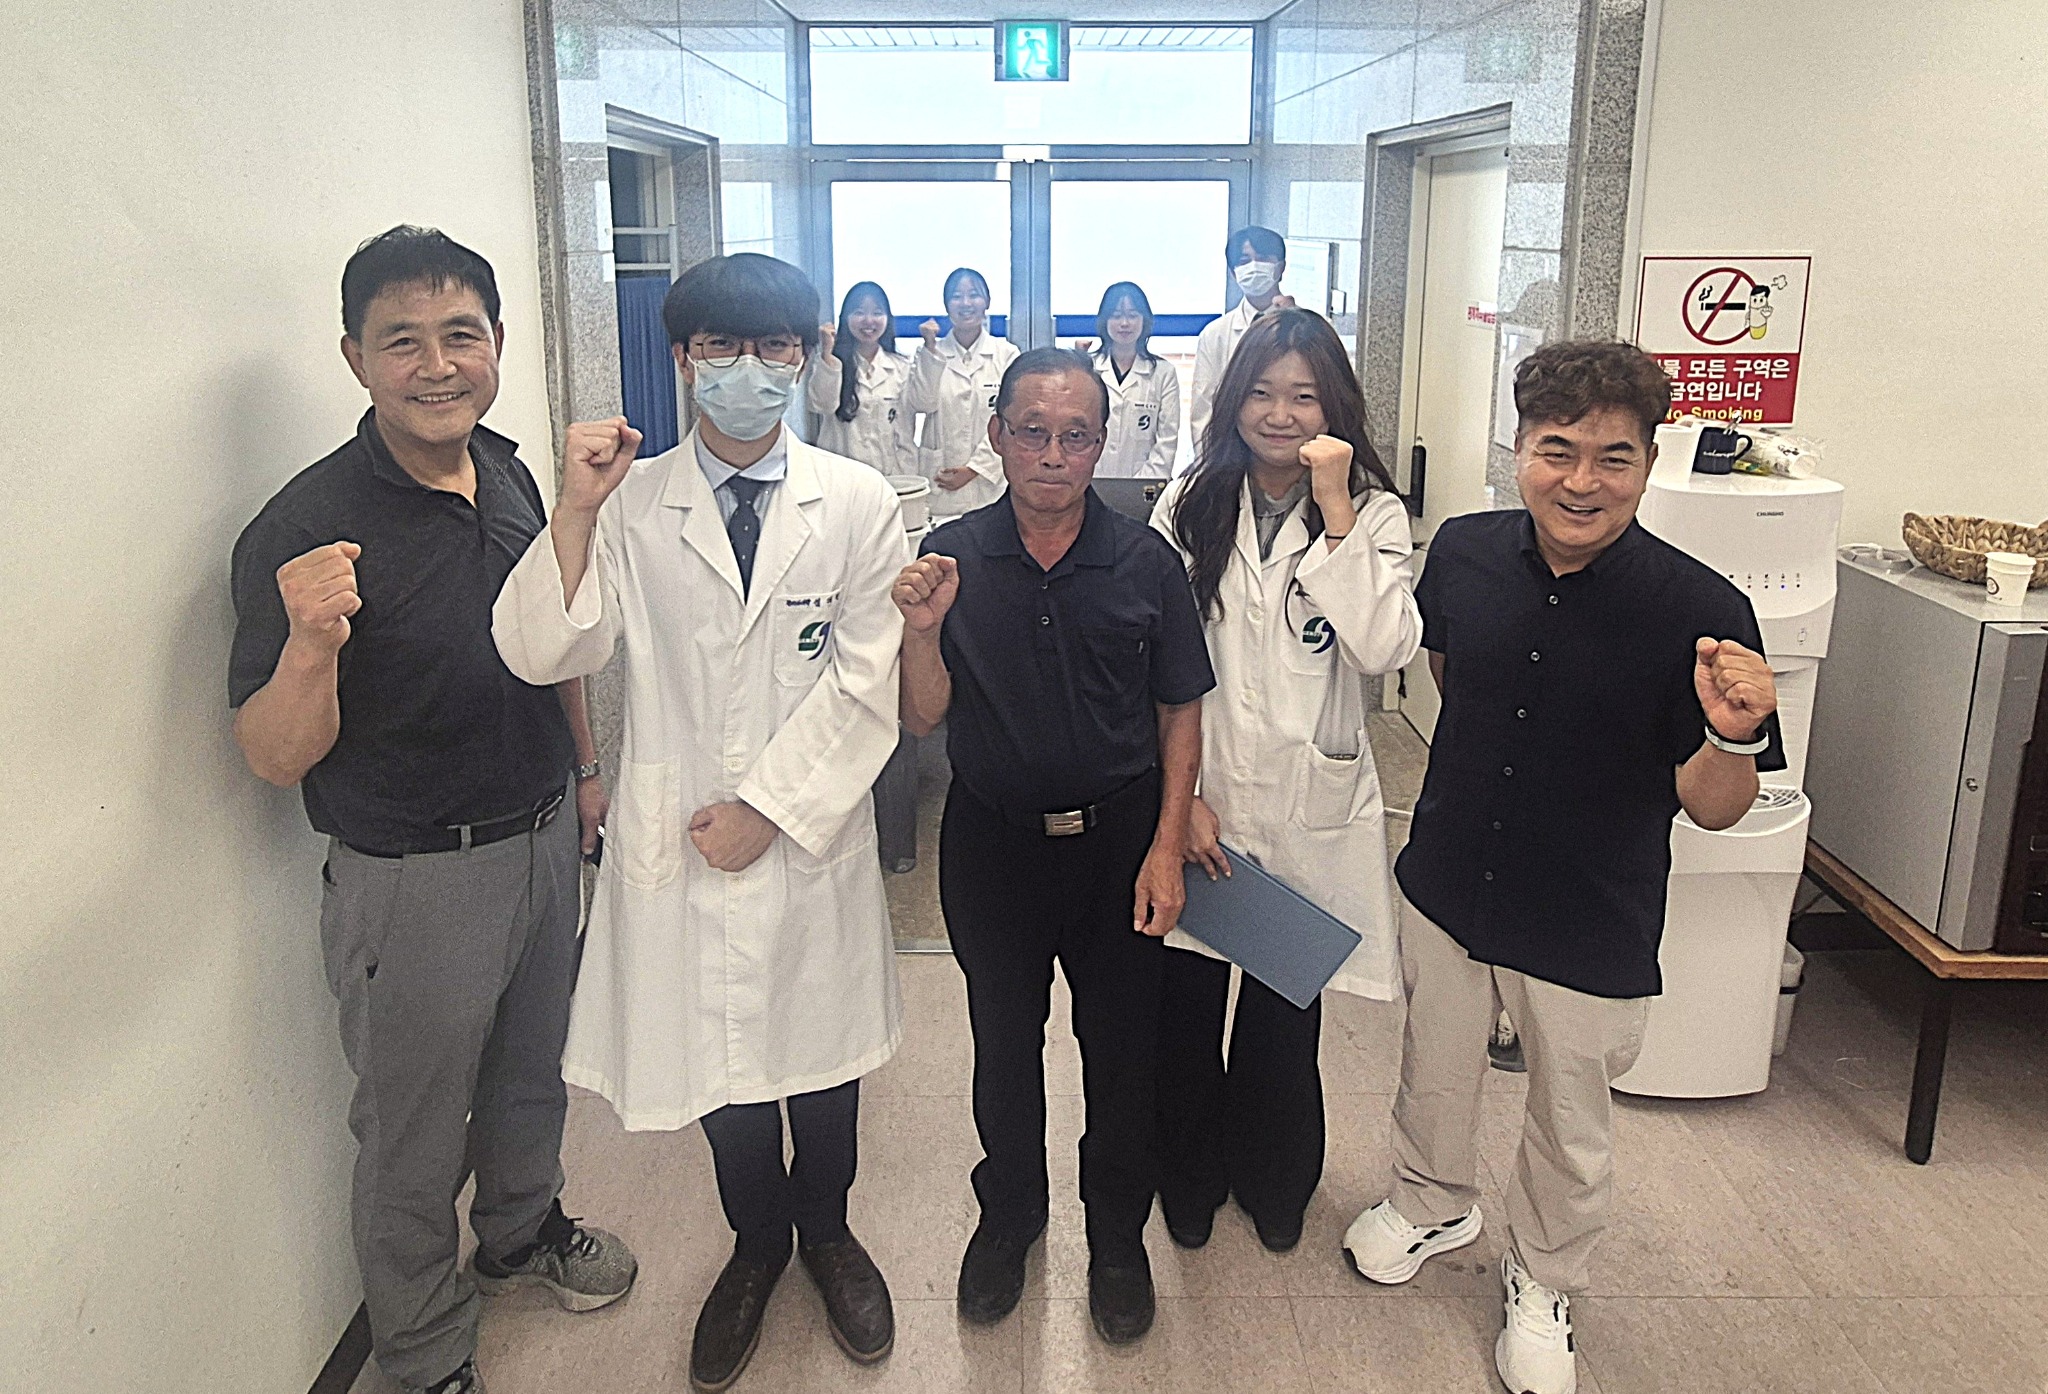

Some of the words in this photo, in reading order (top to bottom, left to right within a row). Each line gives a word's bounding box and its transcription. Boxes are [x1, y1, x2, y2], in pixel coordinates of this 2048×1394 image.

[1657, 359, 1681, 379] 물
[1687, 359, 1727, 379] 모든
[1733, 358, 1790, 379] 구역은
[1670, 381, 1762, 402] 금연입니다
[1691, 406, 1763, 421] Smoking
